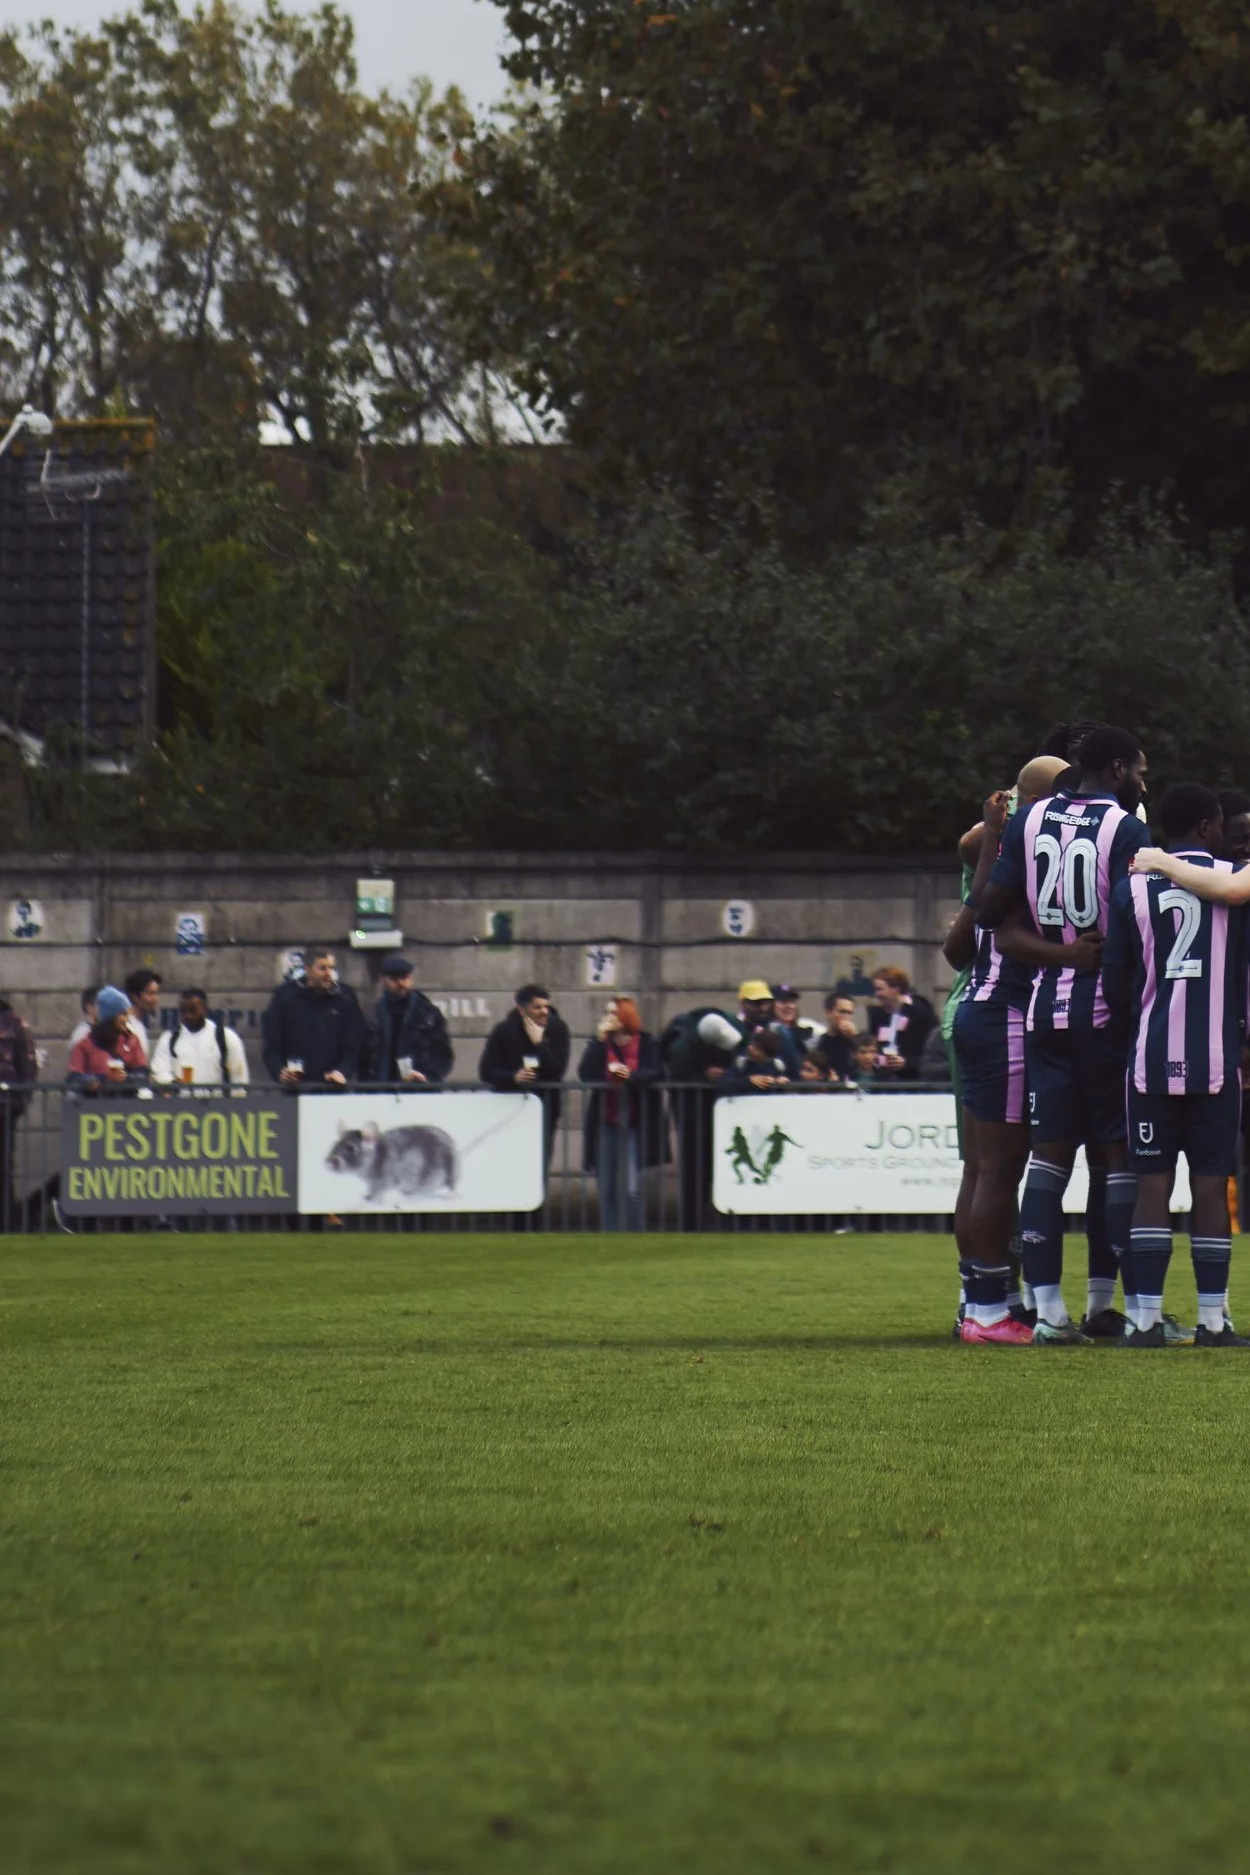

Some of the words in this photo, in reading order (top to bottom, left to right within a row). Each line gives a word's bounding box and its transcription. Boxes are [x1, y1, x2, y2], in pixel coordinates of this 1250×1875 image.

[1032, 834, 1099, 928] 20
[1157, 888, 1203, 980] 2
[79, 1112, 279, 1161] PESTGONE
[69, 1166, 289, 1200] ENVIRONMENTAL
[807, 1155, 878, 1170] SPORTS
